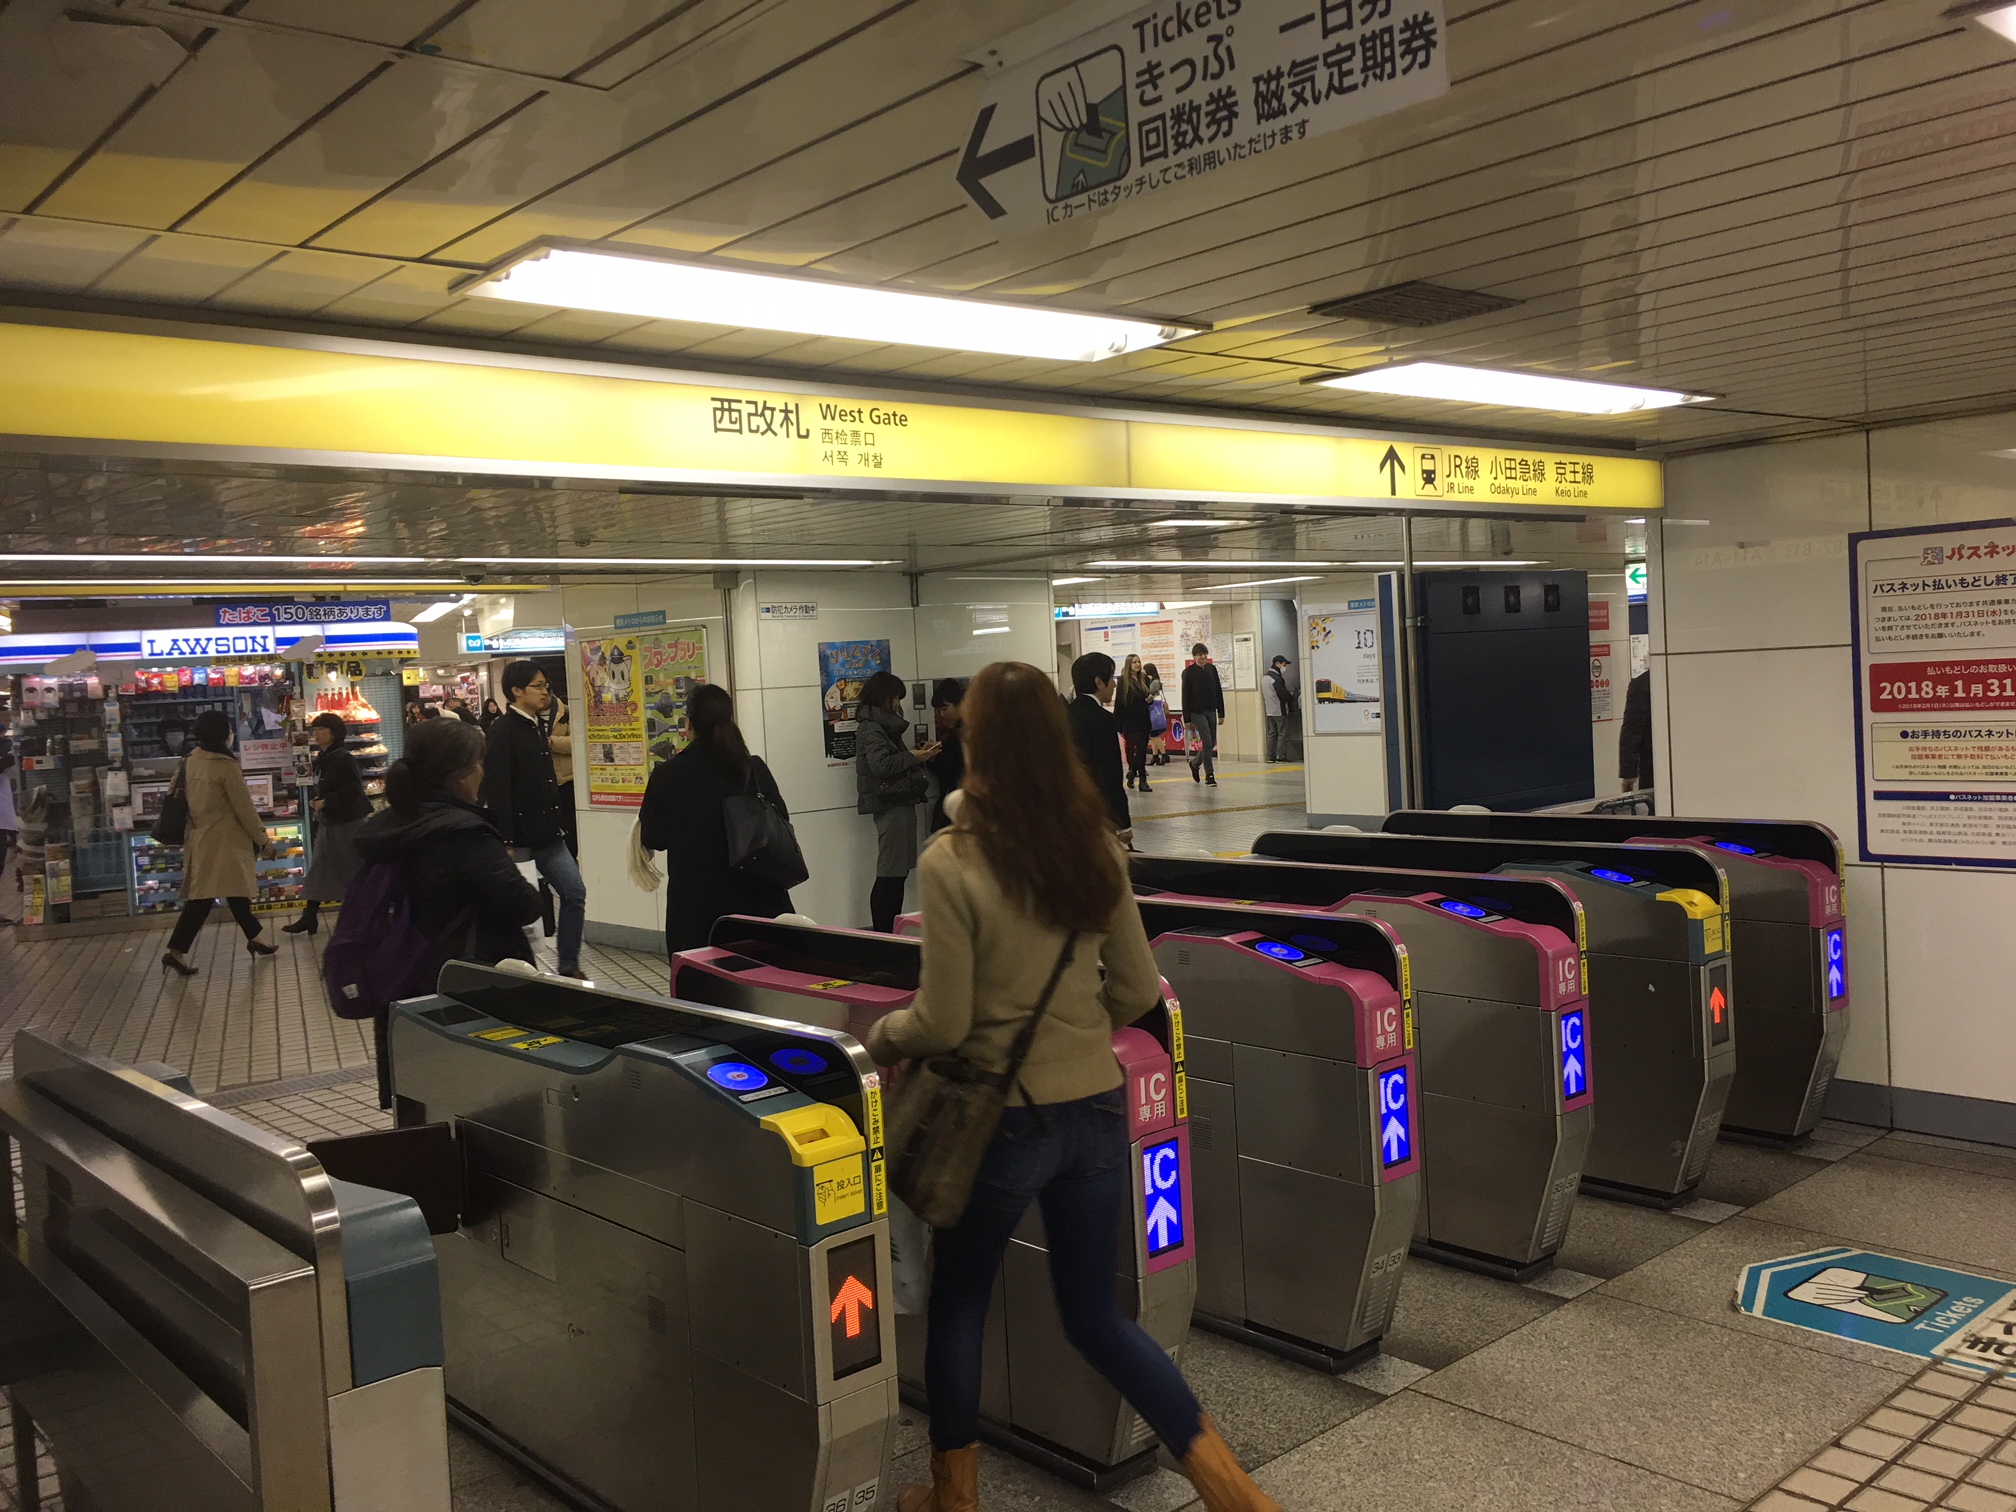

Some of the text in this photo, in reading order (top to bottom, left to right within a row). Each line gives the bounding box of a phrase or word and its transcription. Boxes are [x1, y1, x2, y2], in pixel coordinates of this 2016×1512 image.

[1133, 0, 1242, 54] Tickets
[1135, 26, 1237, 107] きっぷ
[1138, 10, 1438, 168] 回数券 磁気定期券
[710, 396, 810, 440] 西改札
[819, 402, 908, 428] West Gate
[820, 427, 876, 447] 西检票口
[821, 449, 884, 469] 서쪽 개찰
[1445, 453, 1595, 486] JR線 小田急線 京王線
[1446, 482, 1588, 499] JR Line Odakyu Line Keio Line
[219, 603, 387, 624] たばこ 150銘柄あります
[147, 635, 269, 657] LAWSON
[1825, 884, 1838, 904] IC
[1828, 933, 1841, 962] IC
[1558, 957, 1575, 982] IC
[1558, 979, 1576, 996] 専用
[1376, 1007, 1397, 1035] IC
[1375, 1032, 1397, 1051] 専用
[1561, 1016, 1581, 1053] IC
[1138, 1072, 1166, 1105] IC
[1379, 1073, 1404, 1115] IC
[870, 1090, 880, 1145] かけこみ禁止
[1138, 1100, 1166, 1123] 専用
[836, 1174, 861, 1192] 投入口
[1143, 1147, 1176, 1195] IC
[1371, 1252, 1402, 1274] 34 33
[1913, 1296, 1985, 1333] Tickets
[854, 1484, 876, 1506] 35
